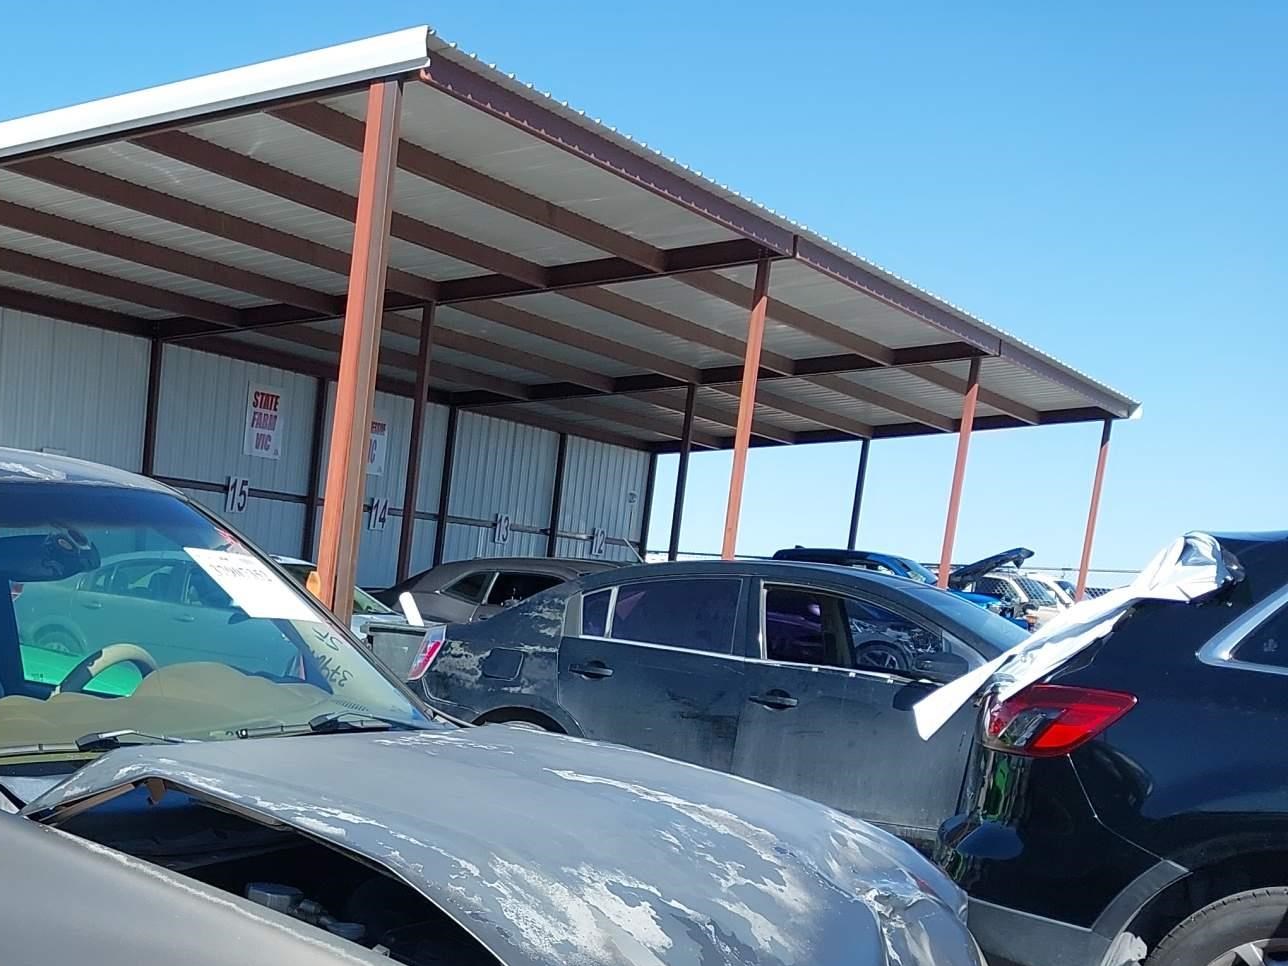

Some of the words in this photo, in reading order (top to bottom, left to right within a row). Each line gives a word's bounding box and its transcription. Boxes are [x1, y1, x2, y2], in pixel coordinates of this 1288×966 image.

[252, 390, 281, 412] STATE
[250, 411, 278, 432] FARM
[255, 432, 273, 451] VIC
[367, 439, 378, 465] IC
[229, 478, 249, 512] 15
[372, 498, 388, 528] 14
[496, 514, 510, 543] 13
[593, 528, 607, 556] 12
